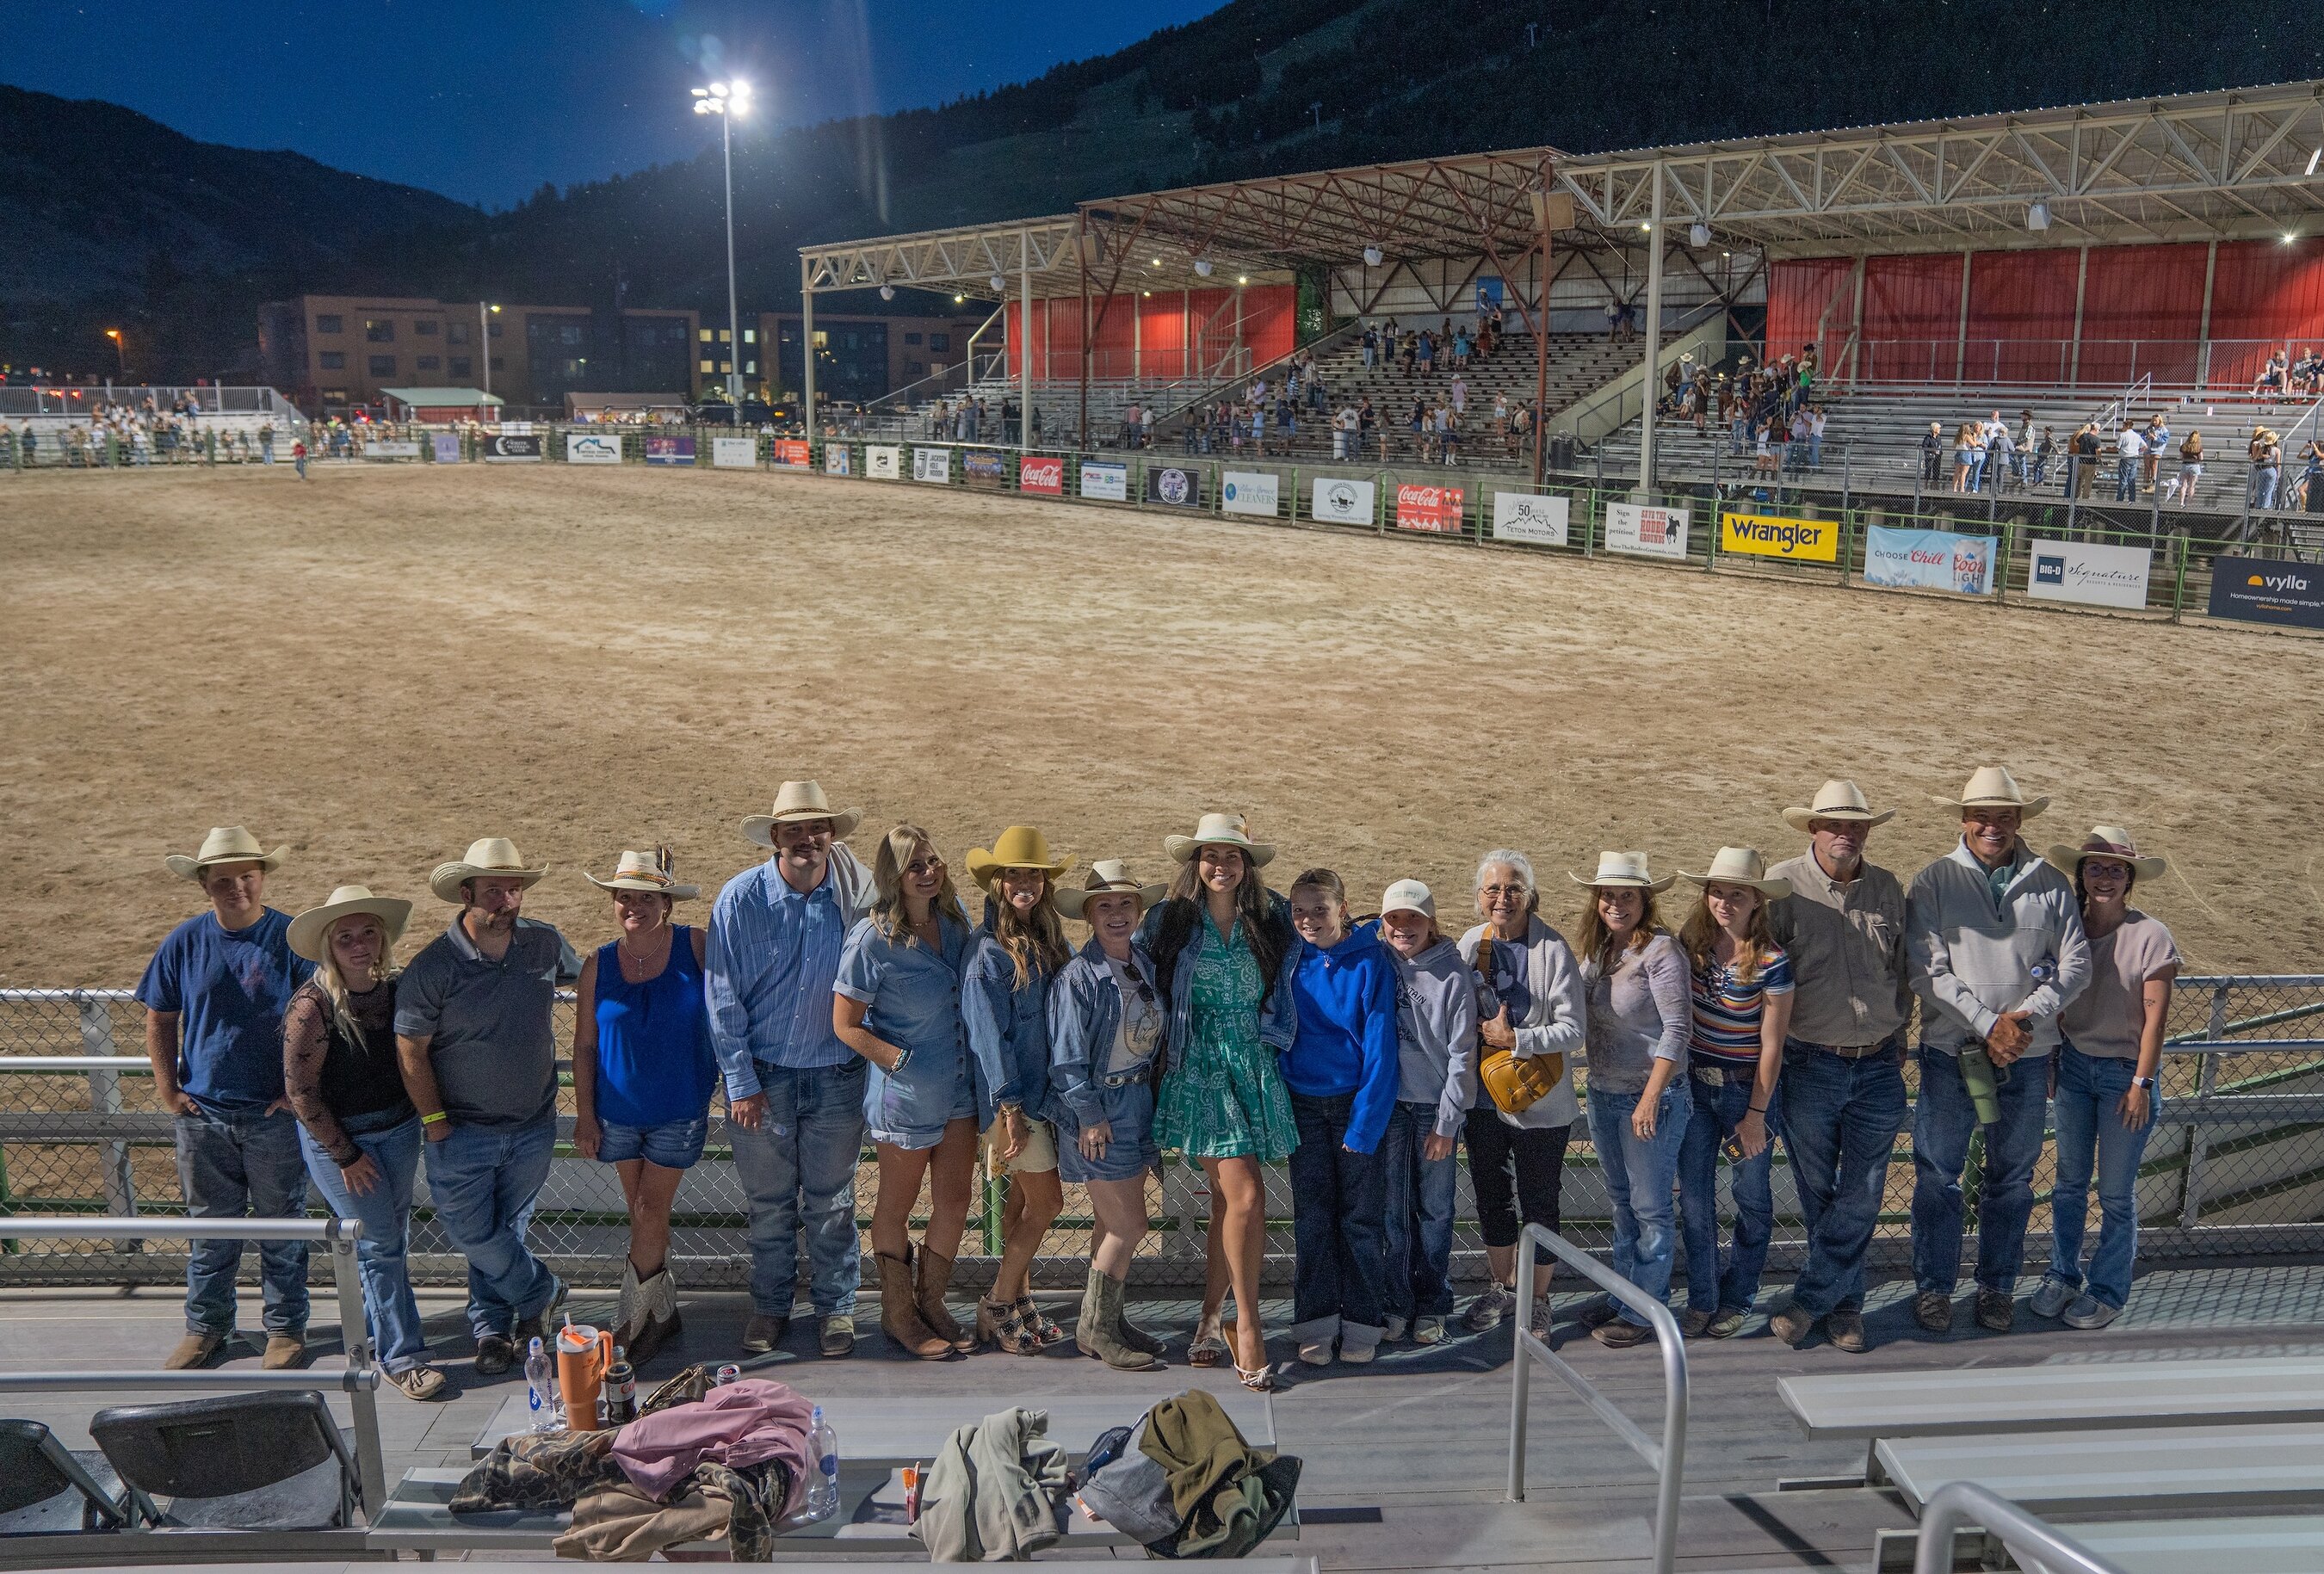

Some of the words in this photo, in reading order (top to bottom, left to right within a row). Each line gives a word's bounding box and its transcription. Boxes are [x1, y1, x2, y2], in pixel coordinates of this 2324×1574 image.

[1238, 483, 1253, 492] Blue
[1237, 493, 1276, 504] CLEANERS
[1518, 504, 1530, 516] 50
[1616, 509, 1630, 517] Sign
[1641, 509, 1654, 520] SAVE
[1656, 511, 1666, 520] THE
[1528, 528, 1555, 537] MOTORS
[1640, 520, 1666, 534] RODEO
[1639, 533, 1665, 544] GROUNDS
[1731, 518, 1822, 553] Wrangler
[1610, 543, 1679, 556] SaveTheRodeoGrounds.com
[1875, 550, 1908, 560] CHOOSE
[1910, 549, 1945, 565] Chill
[2039, 565, 2061, 576] BIG-D
[2067, 562, 2141, 586] Signature
[2265, 575, 2308, 592] vylla
[2230, 592, 2279, 604] Homeownership
[2256, 603, 2292, 613] vyllahome.com
